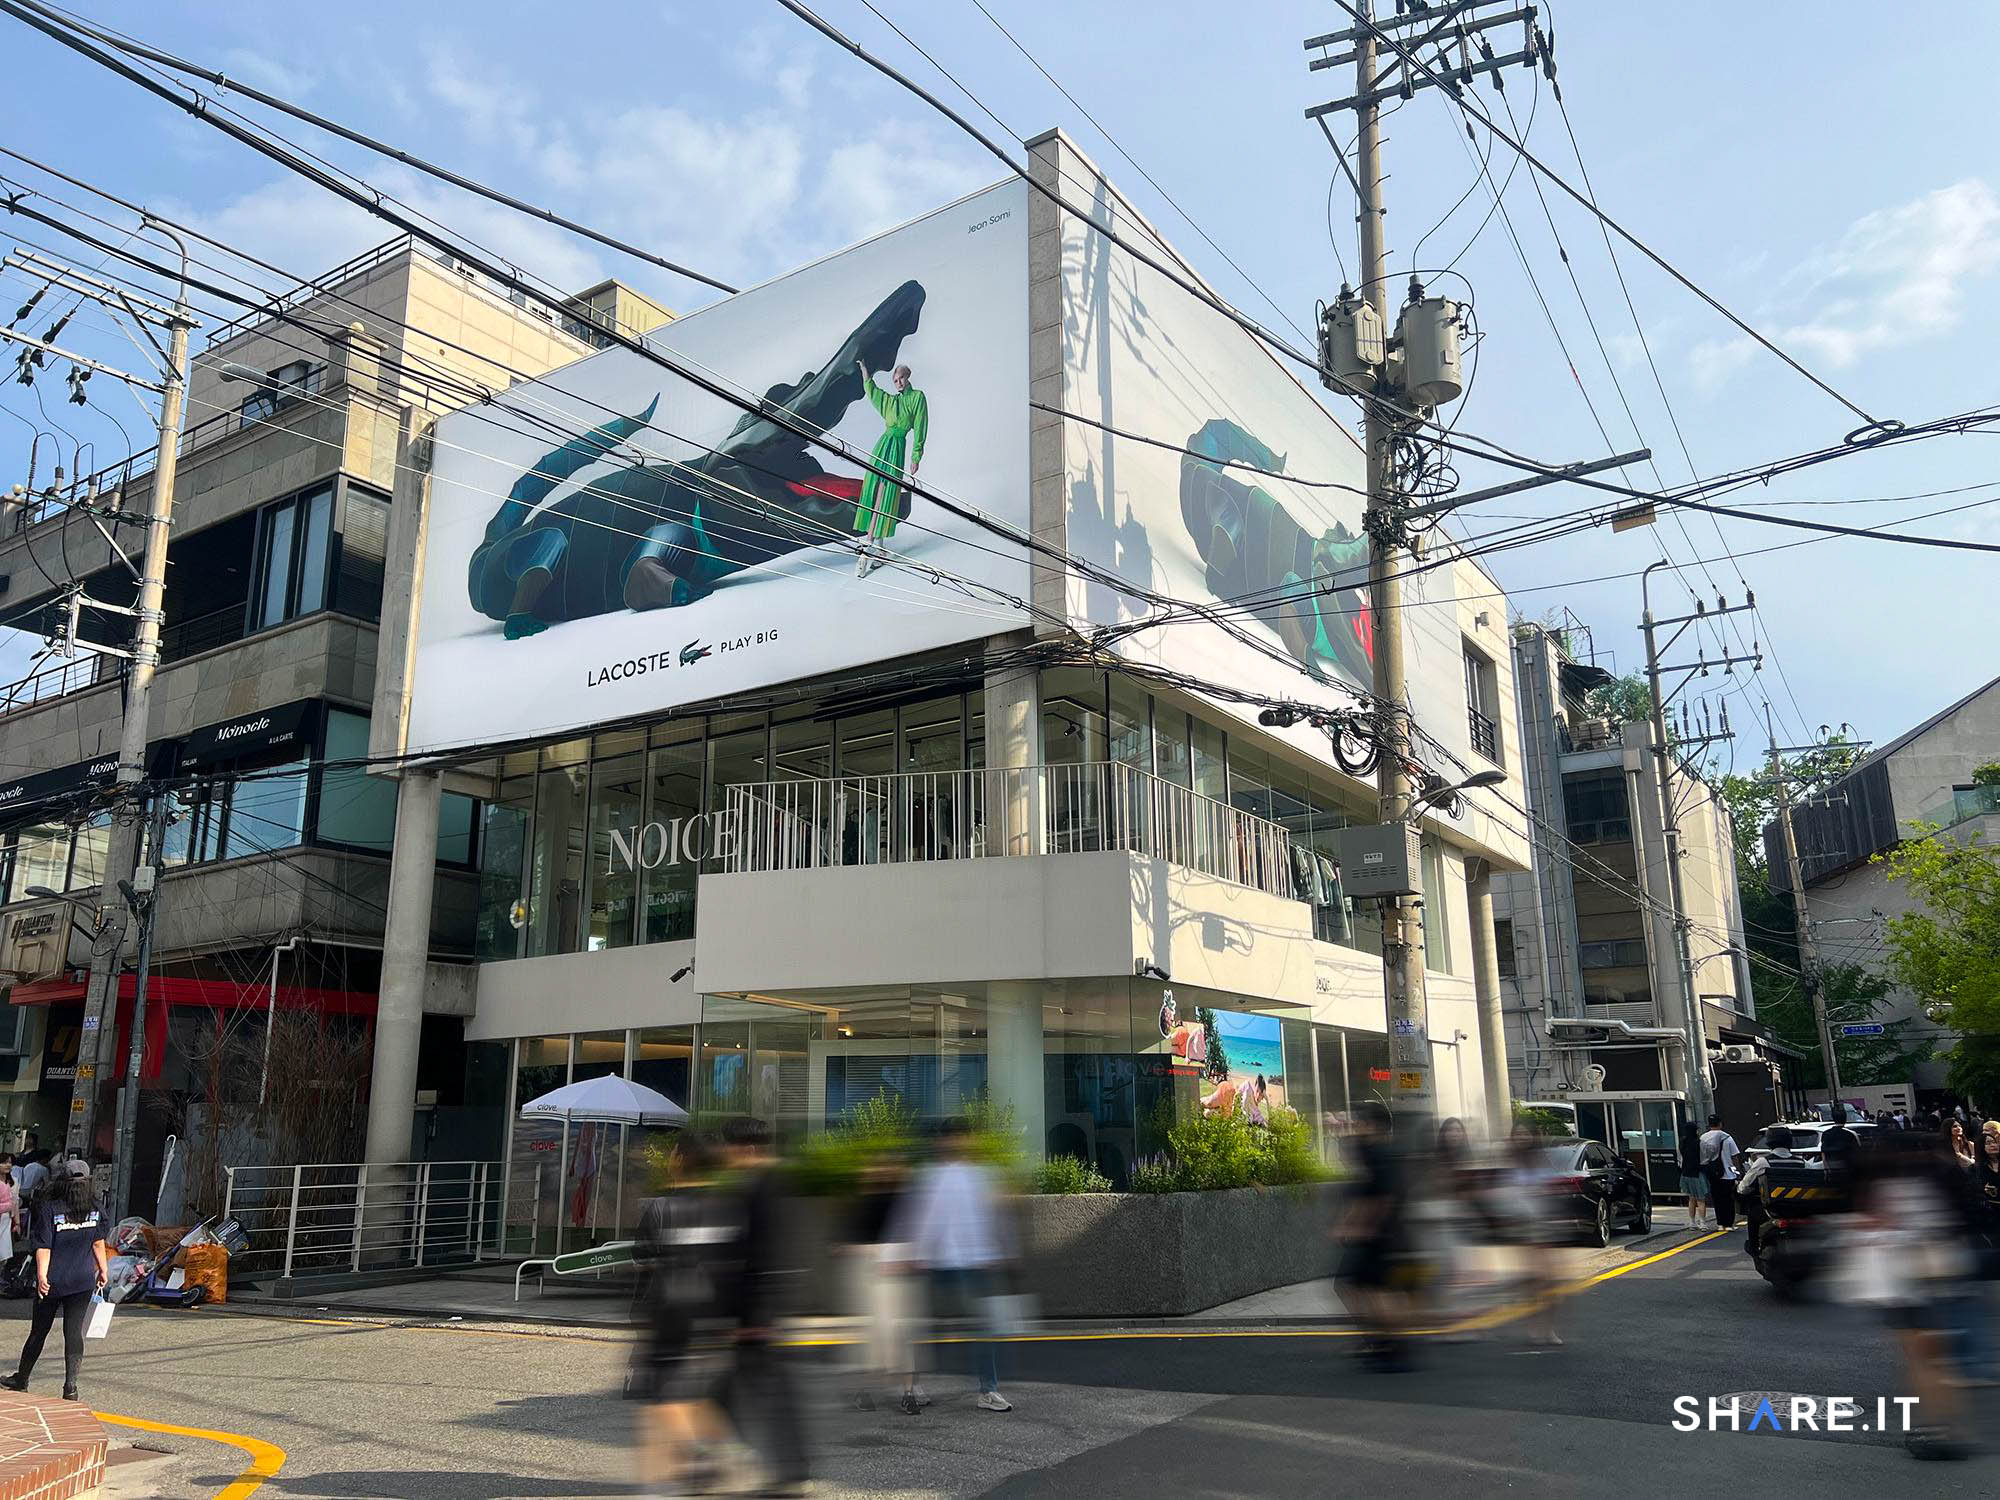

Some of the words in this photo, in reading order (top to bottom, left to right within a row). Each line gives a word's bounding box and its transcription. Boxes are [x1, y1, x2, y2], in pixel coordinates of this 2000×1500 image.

[587, 651, 670, 687] LACOSTE
[720, 635, 752, 653] PLAY
[756, 629, 779, 645] BIG
[215, 717, 270, 742] Monocle
[605, 808, 739, 876] NOICE
